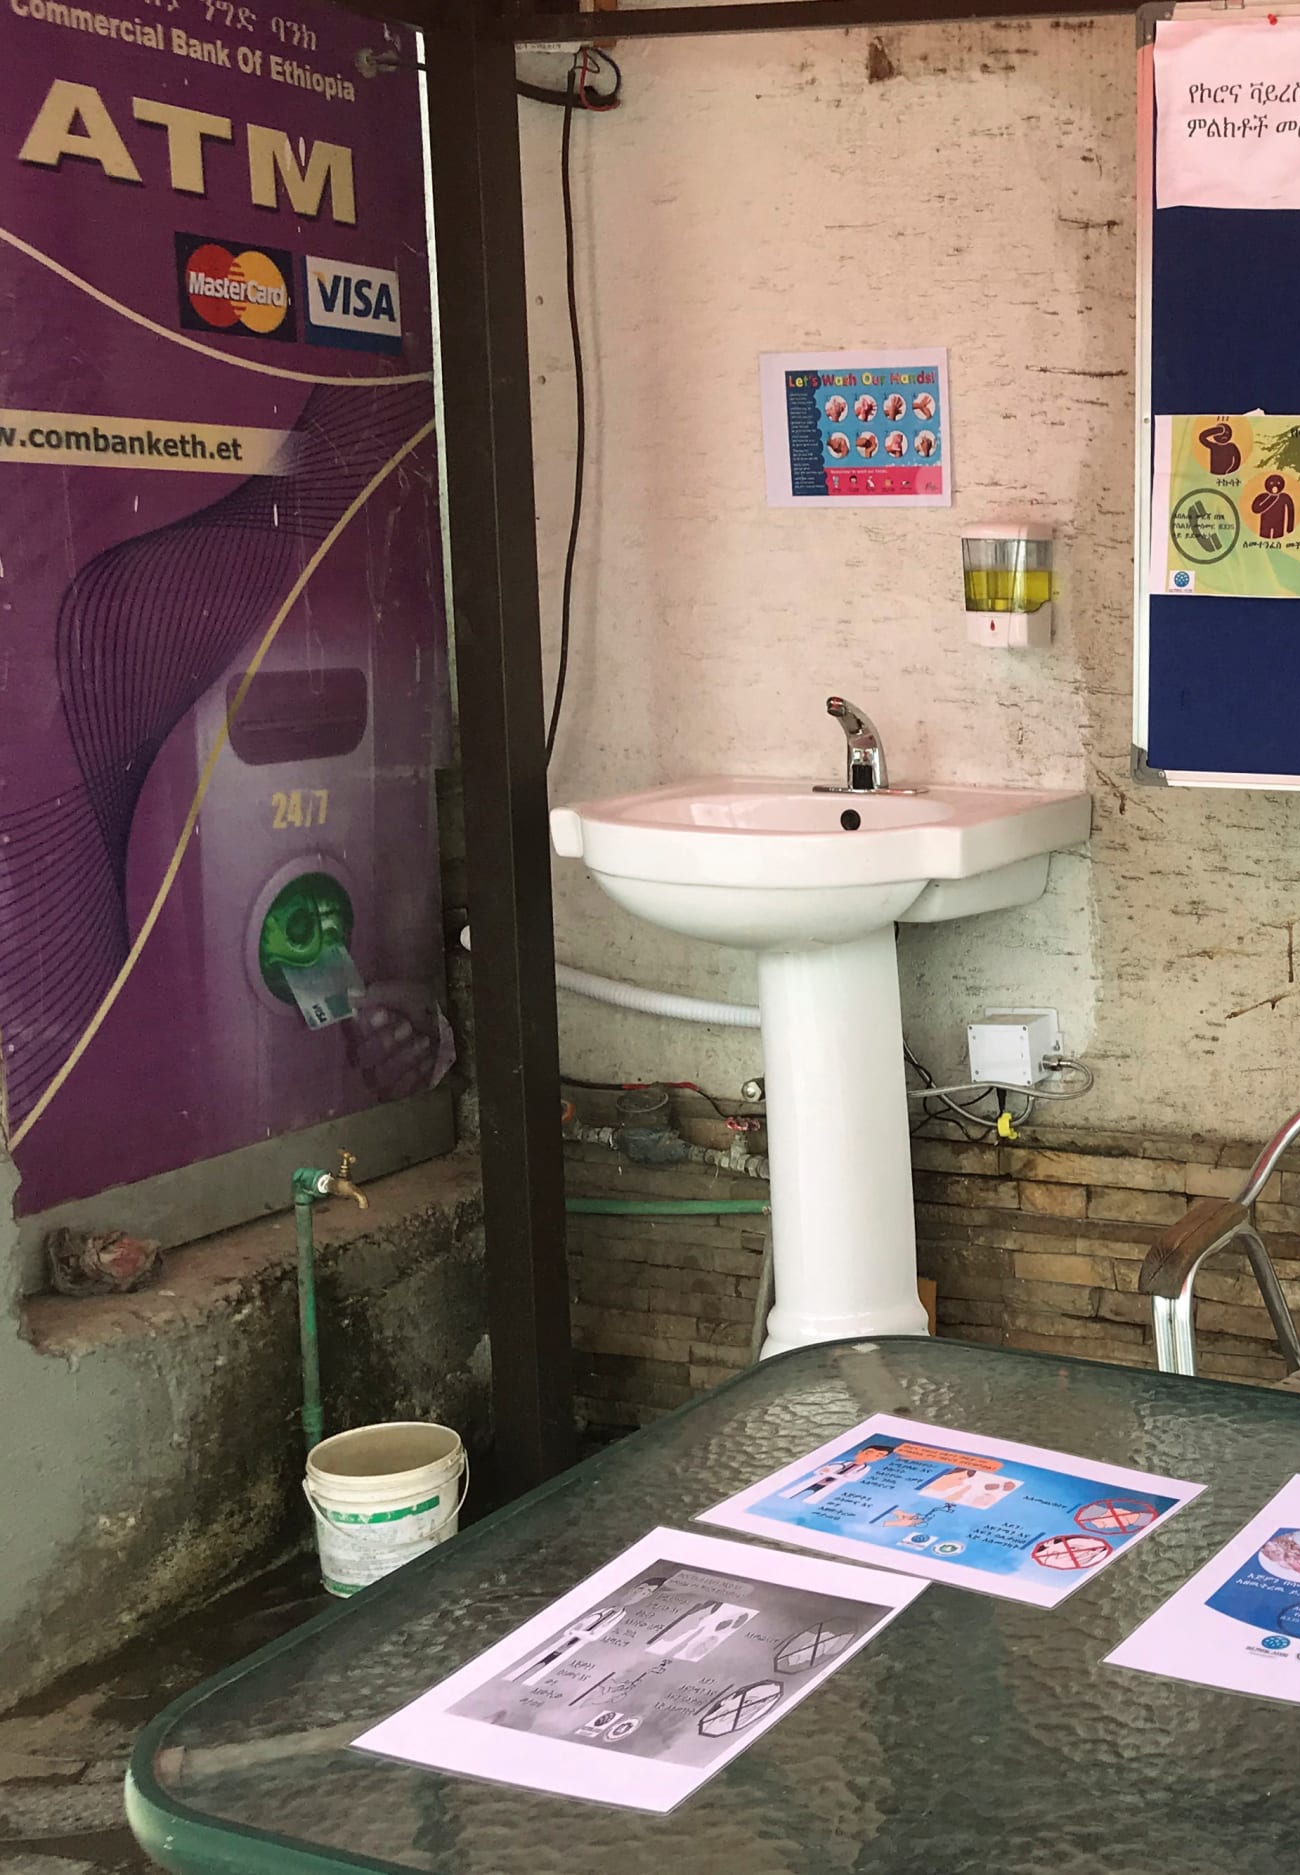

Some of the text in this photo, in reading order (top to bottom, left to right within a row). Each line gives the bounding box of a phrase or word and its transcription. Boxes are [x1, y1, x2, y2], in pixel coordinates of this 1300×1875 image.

[10, 0, 356, 102] Commercial Bank Of Ethiopia
[271, 16, 316, 50] ባንክ
[1188, 83, 1242, 104] የኮሮና
[1187, 114, 1268, 138] ምልክቶች
[18, 78, 357, 225] ATM
[189, 271, 285, 307] MasterCard
[315, 273, 397, 323] VISA
[788, 372, 935, 388] Let's Wash Our Hands!
[272, 789, 328, 829] 24/7
